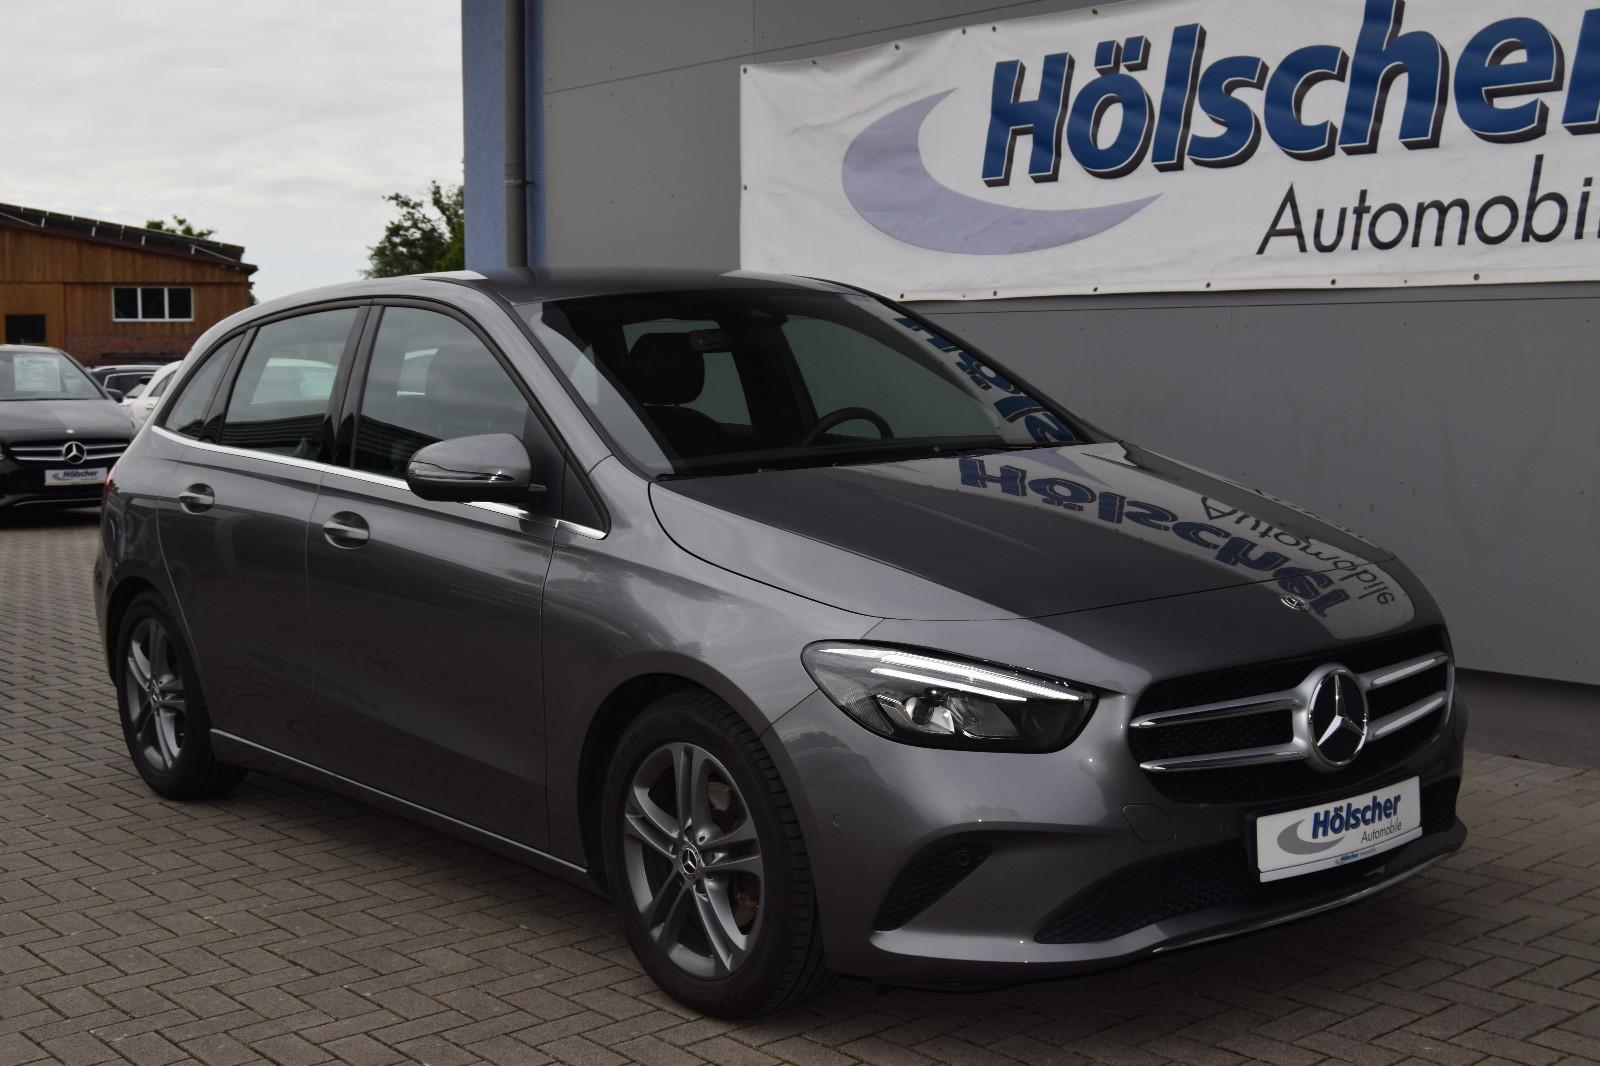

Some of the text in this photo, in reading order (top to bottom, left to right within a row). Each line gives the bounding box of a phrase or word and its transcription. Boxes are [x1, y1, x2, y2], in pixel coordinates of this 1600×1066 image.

[1256, 154, 1600, 253] Automobi
[1312, 794, 1401, 840] Hölscher
[1361, 817, 1402, 842] Automobile
